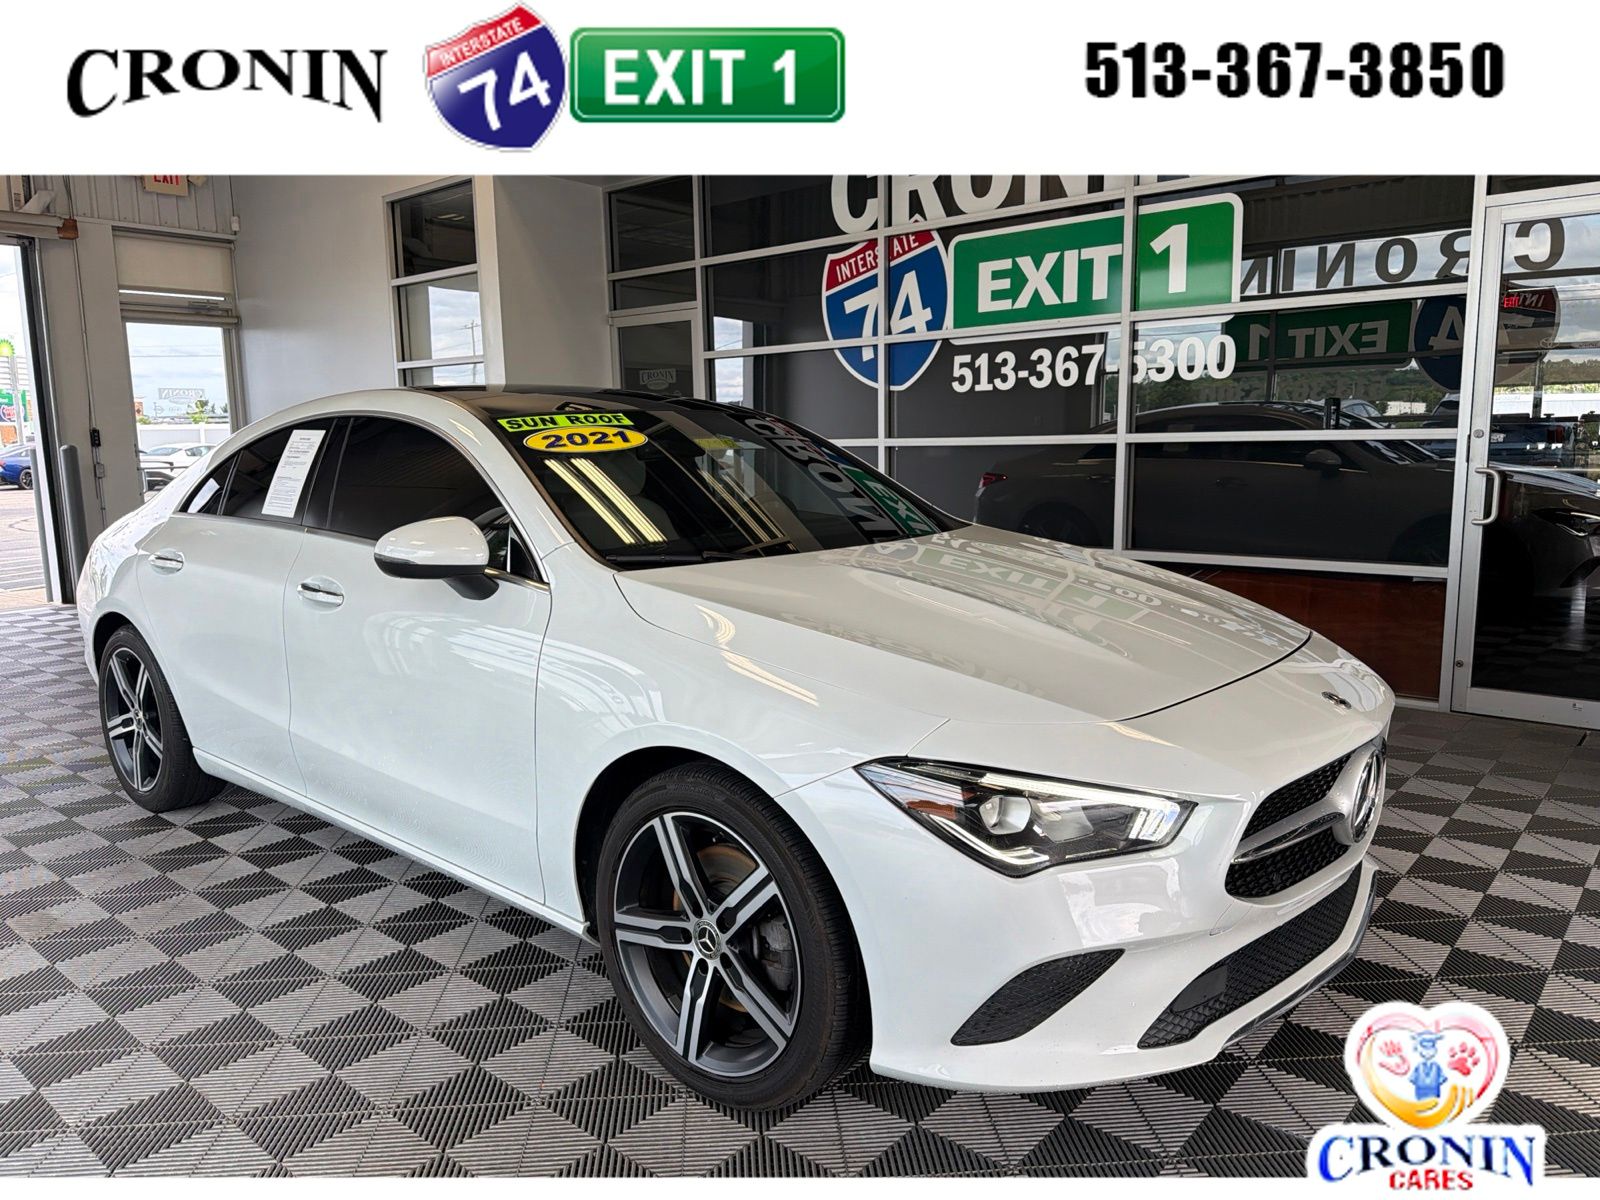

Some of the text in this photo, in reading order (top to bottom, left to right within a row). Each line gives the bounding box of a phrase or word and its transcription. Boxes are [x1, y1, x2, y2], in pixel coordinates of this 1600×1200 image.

[977, 222, 1188, 313] EXIT 1
[844, 270, 933, 362] 74
[951, 334, 1237, 393] 513-367-5300
[506, 414, 627, 430] SUN ROOF
[541, 430, 631, 450] 2021
